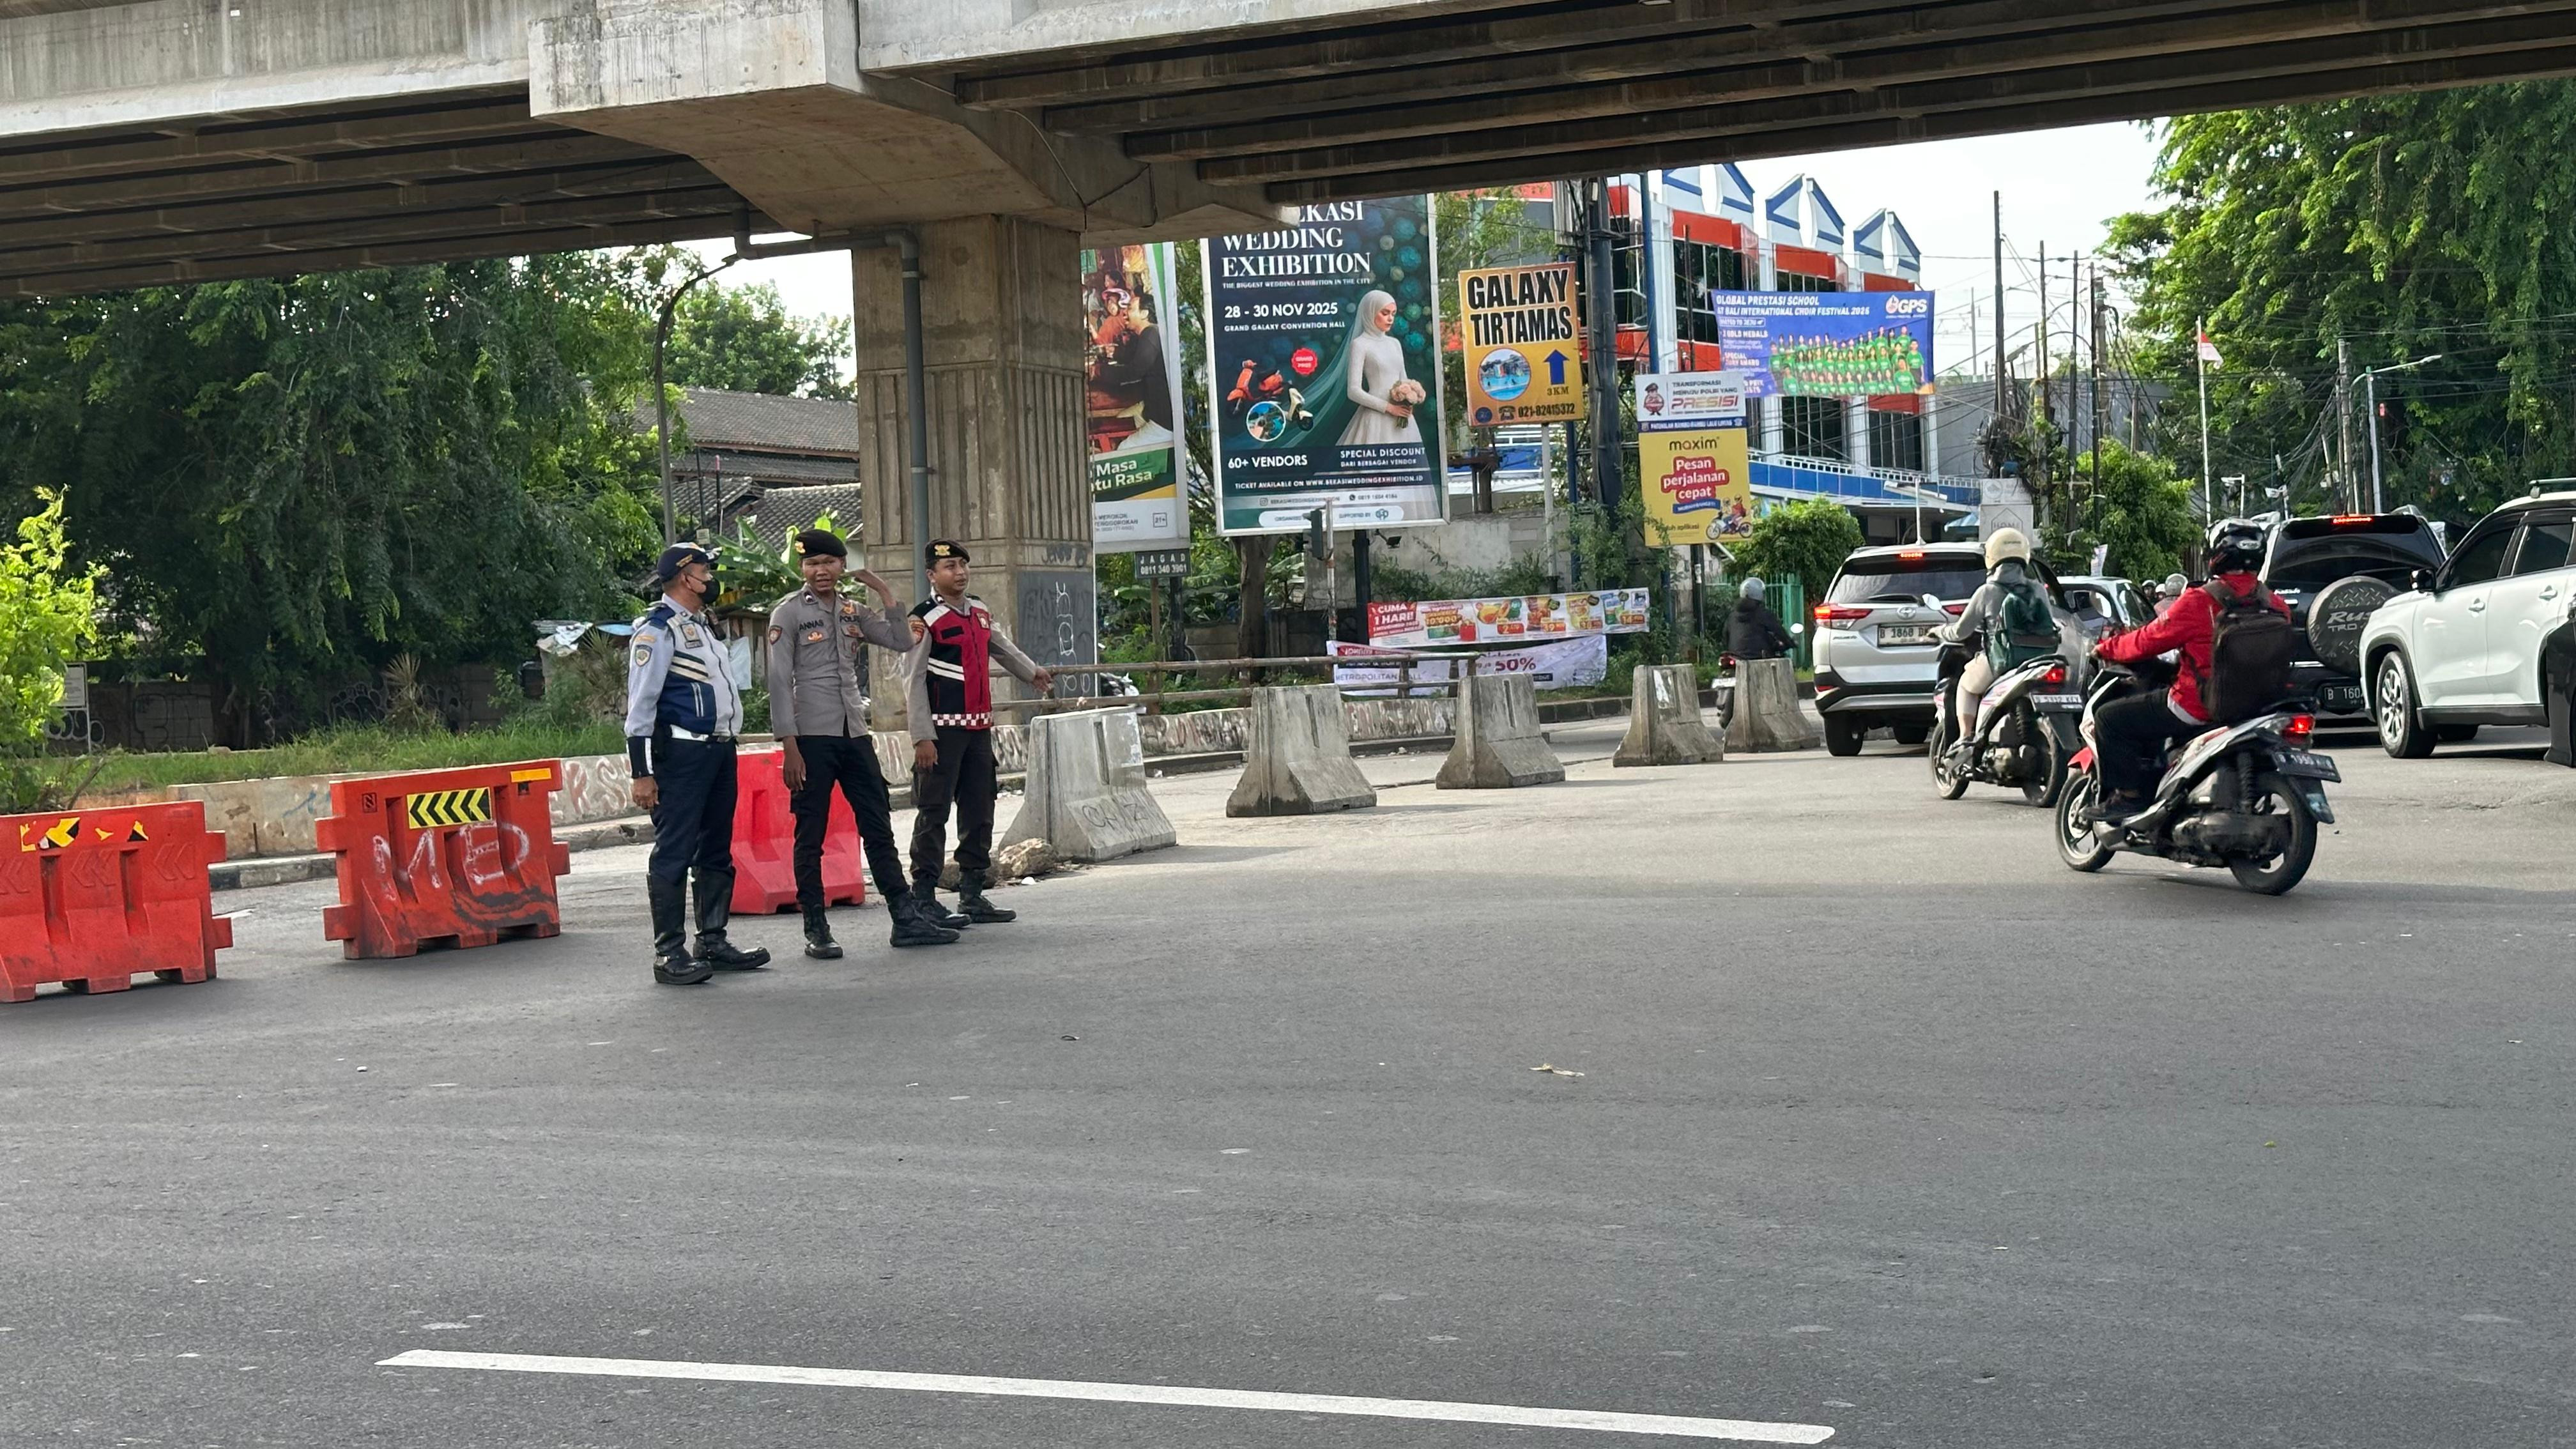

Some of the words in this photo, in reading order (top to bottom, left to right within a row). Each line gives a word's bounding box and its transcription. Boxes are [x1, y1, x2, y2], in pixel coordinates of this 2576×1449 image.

[1223, 227, 1344, 251] WEDDING
[1222, 252, 1371, 277] EXHIBITION
[1467, 268, 1569, 310] GALAXY
[1748, 295, 1786, 305] PRESTASI
[1787, 295, 1820, 306] SCHOOL
[1897, 298, 1928, 314] GPS
[1224, 305, 1241, 318] 28
[1253, 304, 1269, 318] 30
[1273, 303, 1304, 317] NOV
[1307, 302, 1338, 316] 2025
[1725, 307, 1740, 315] BALI
[1741, 307, 1793, 316] INTERNATIONAL
[1794, 307, 1816, 316] CHOIR
[1817, 307, 1850, 316] FESTIVAL
[1281, 321, 1328, 330] CONVENTION
[1469, 305, 1574, 347] TIRTAMAS
[1671, 395, 1738, 410] PRESISI
[1669, 436, 1717, 451] maxim
[1340, 448, 1377, 459] SPECIAL
[1379, 447, 1426, 457] DISCOUNT
[1096, 459, 1137, 477] Masa
[1227, 457, 1249, 470] 60+
[1252, 454, 1308, 468] VENDORS
[1676, 459, 1712, 471] Pesan
[1115, 471, 1153, 487] Rasa
[1663, 471, 1726, 489] perjalanan
[1678, 486, 1712, 500] cepat
[1377, 603, 1407, 613] CUMA
[799, 619, 824, 631] ANNAS
[2327, 624, 2358, 632] TRD
[1494, 657, 1537, 671] 50%
[2327, 688, 2334, 701] B
[2343, 687, 2365, 699] 160
